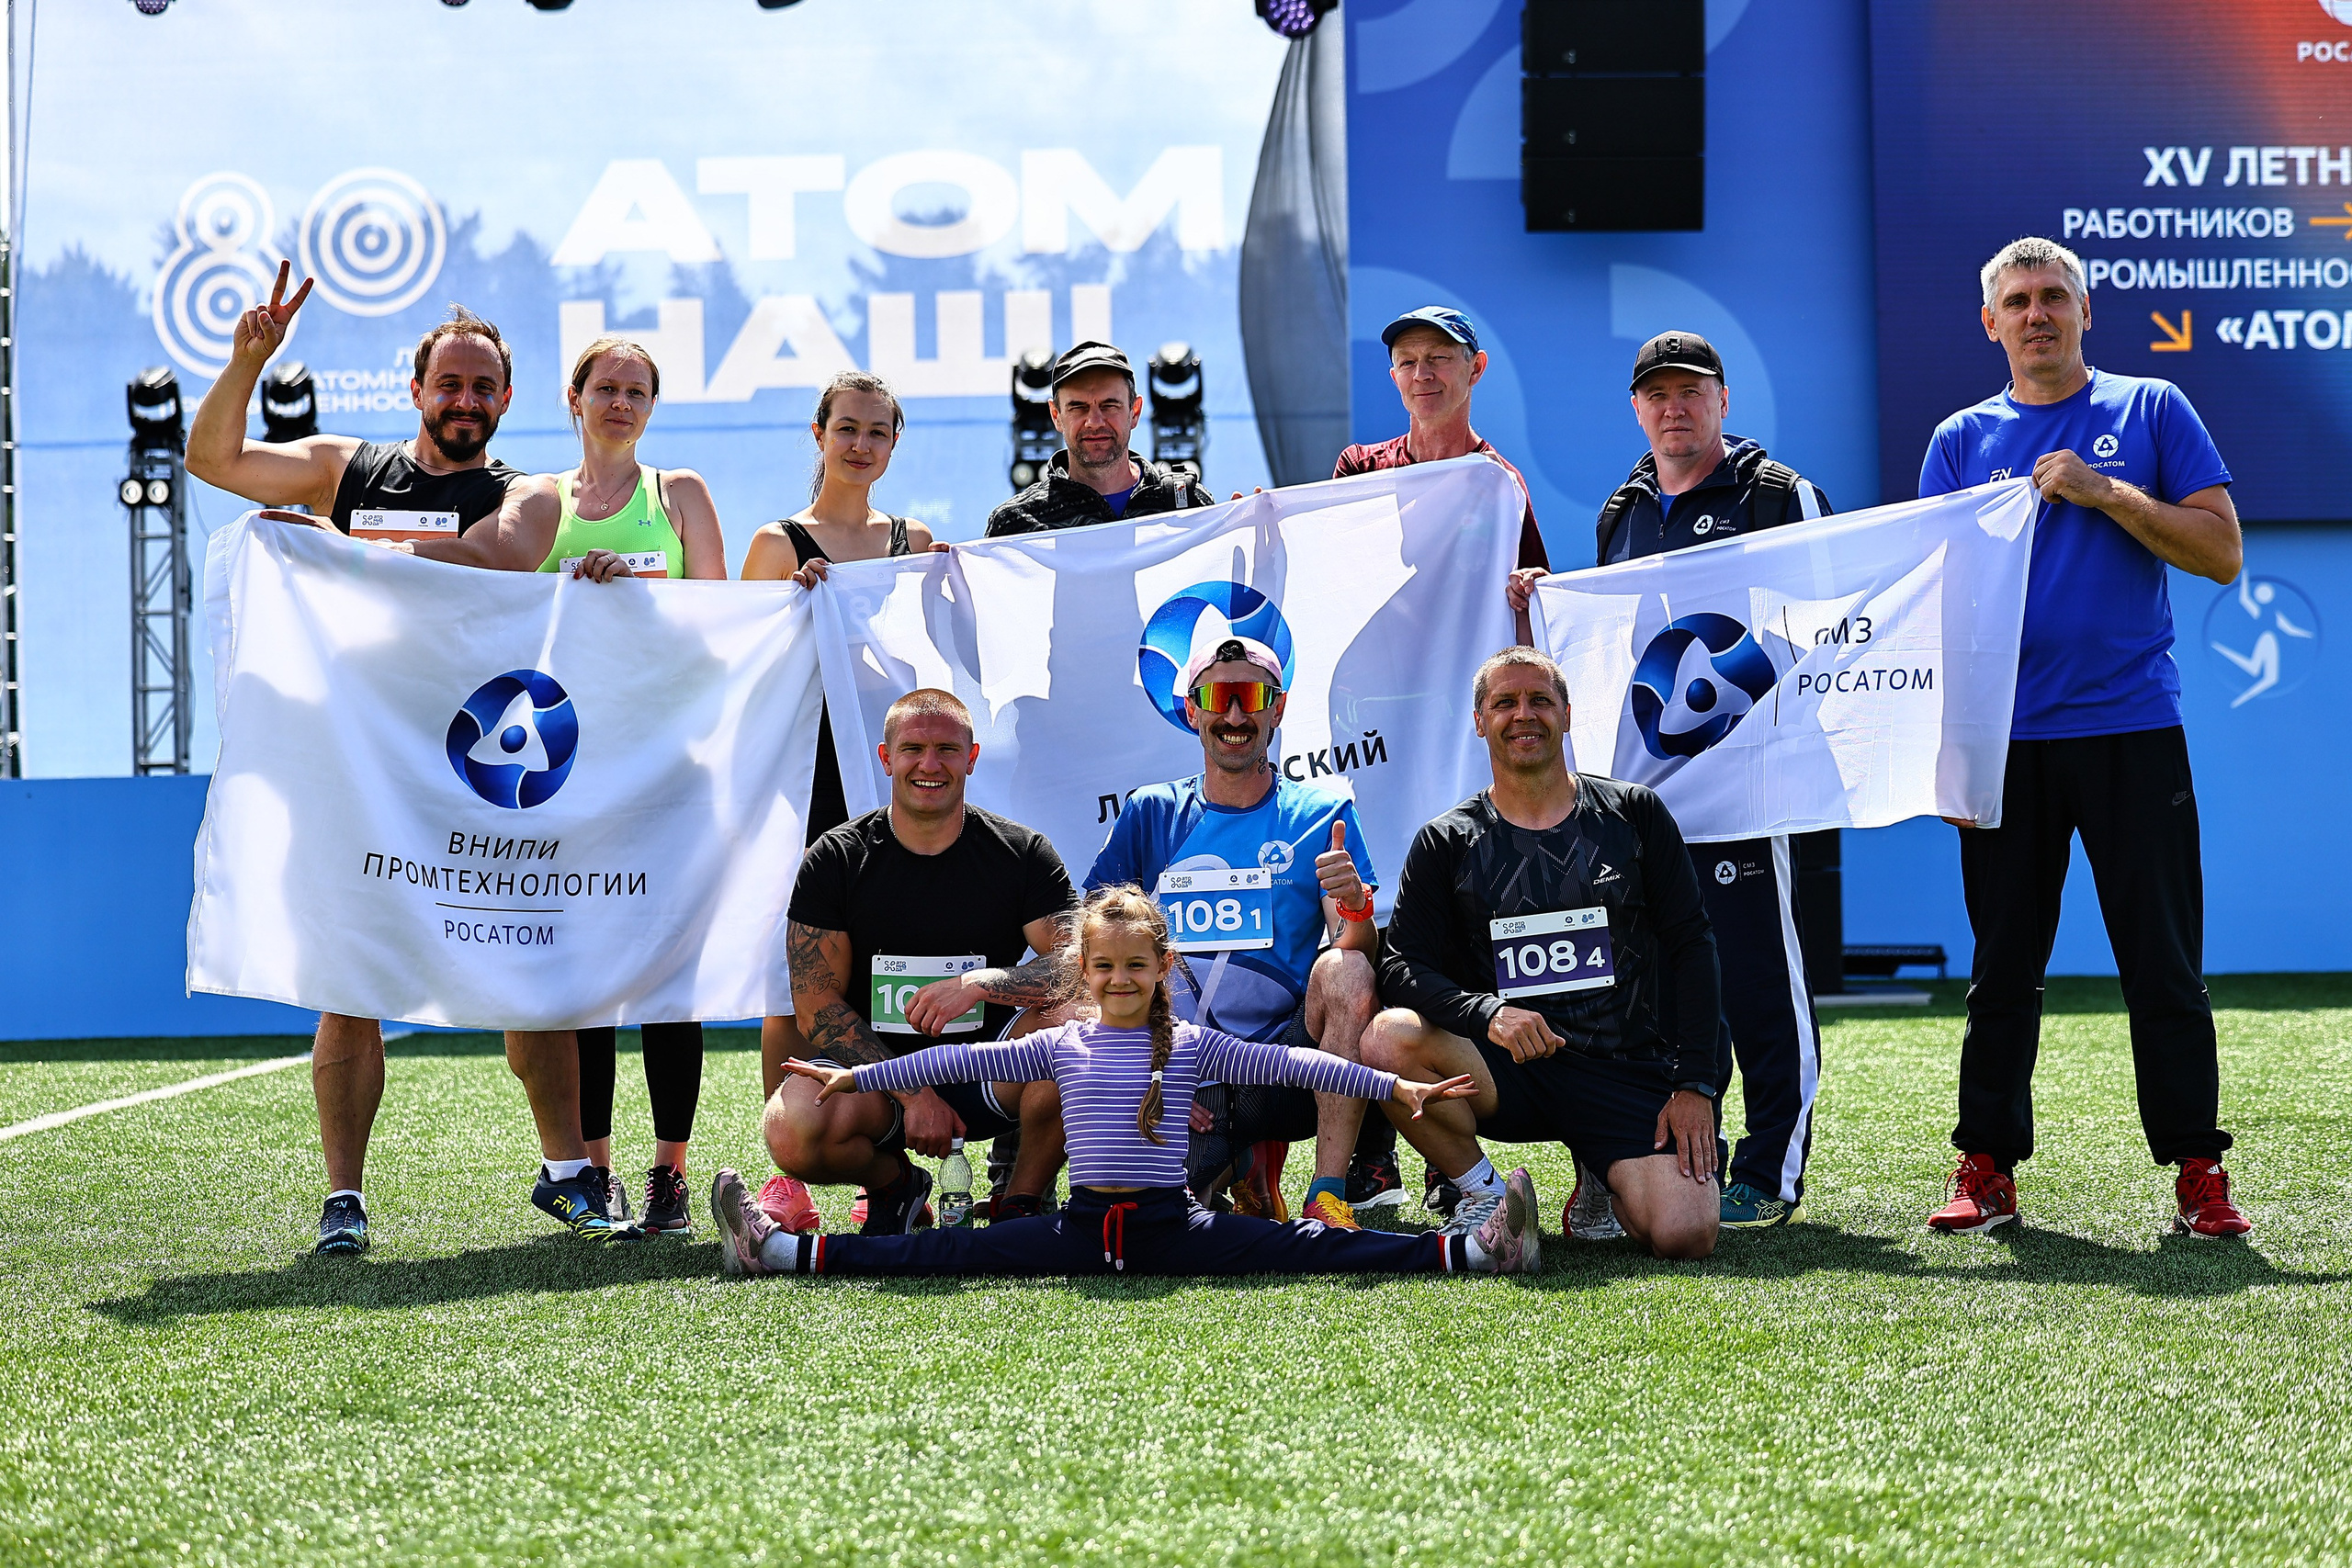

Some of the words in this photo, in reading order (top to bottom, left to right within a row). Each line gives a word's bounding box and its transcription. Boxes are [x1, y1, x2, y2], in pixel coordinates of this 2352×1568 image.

[2297, 40, 2352, 62] РОС
[2142, 146, 2212, 186] XV
[551, 145, 1225, 266] АТОМ
[2063, 207, 2295, 239] РАБОТНИКОВ
[2080, 258, 2352, 290] РОМЫШЛЕННО
[2215, 308, 2352, 350] «АТО
[1797, 668, 1934, 696] РОСАТОМ
[447, 830, 560, 861] ВНИПИ
[363, 852, 648, 897] ПРОМТЕХНОЛОГИИ
[1593, 874, 1622, 886] DEMIX
[1168, 898, 1243, 933] 108
[1250, 908, 1262, 930] 1
[443, 919, 555, 946] РОСАТОМ
[1498, 940, 1578, 979] 108
[1586, 946, 1606, 968] 4
[876, 983, 920, 1015] 10
